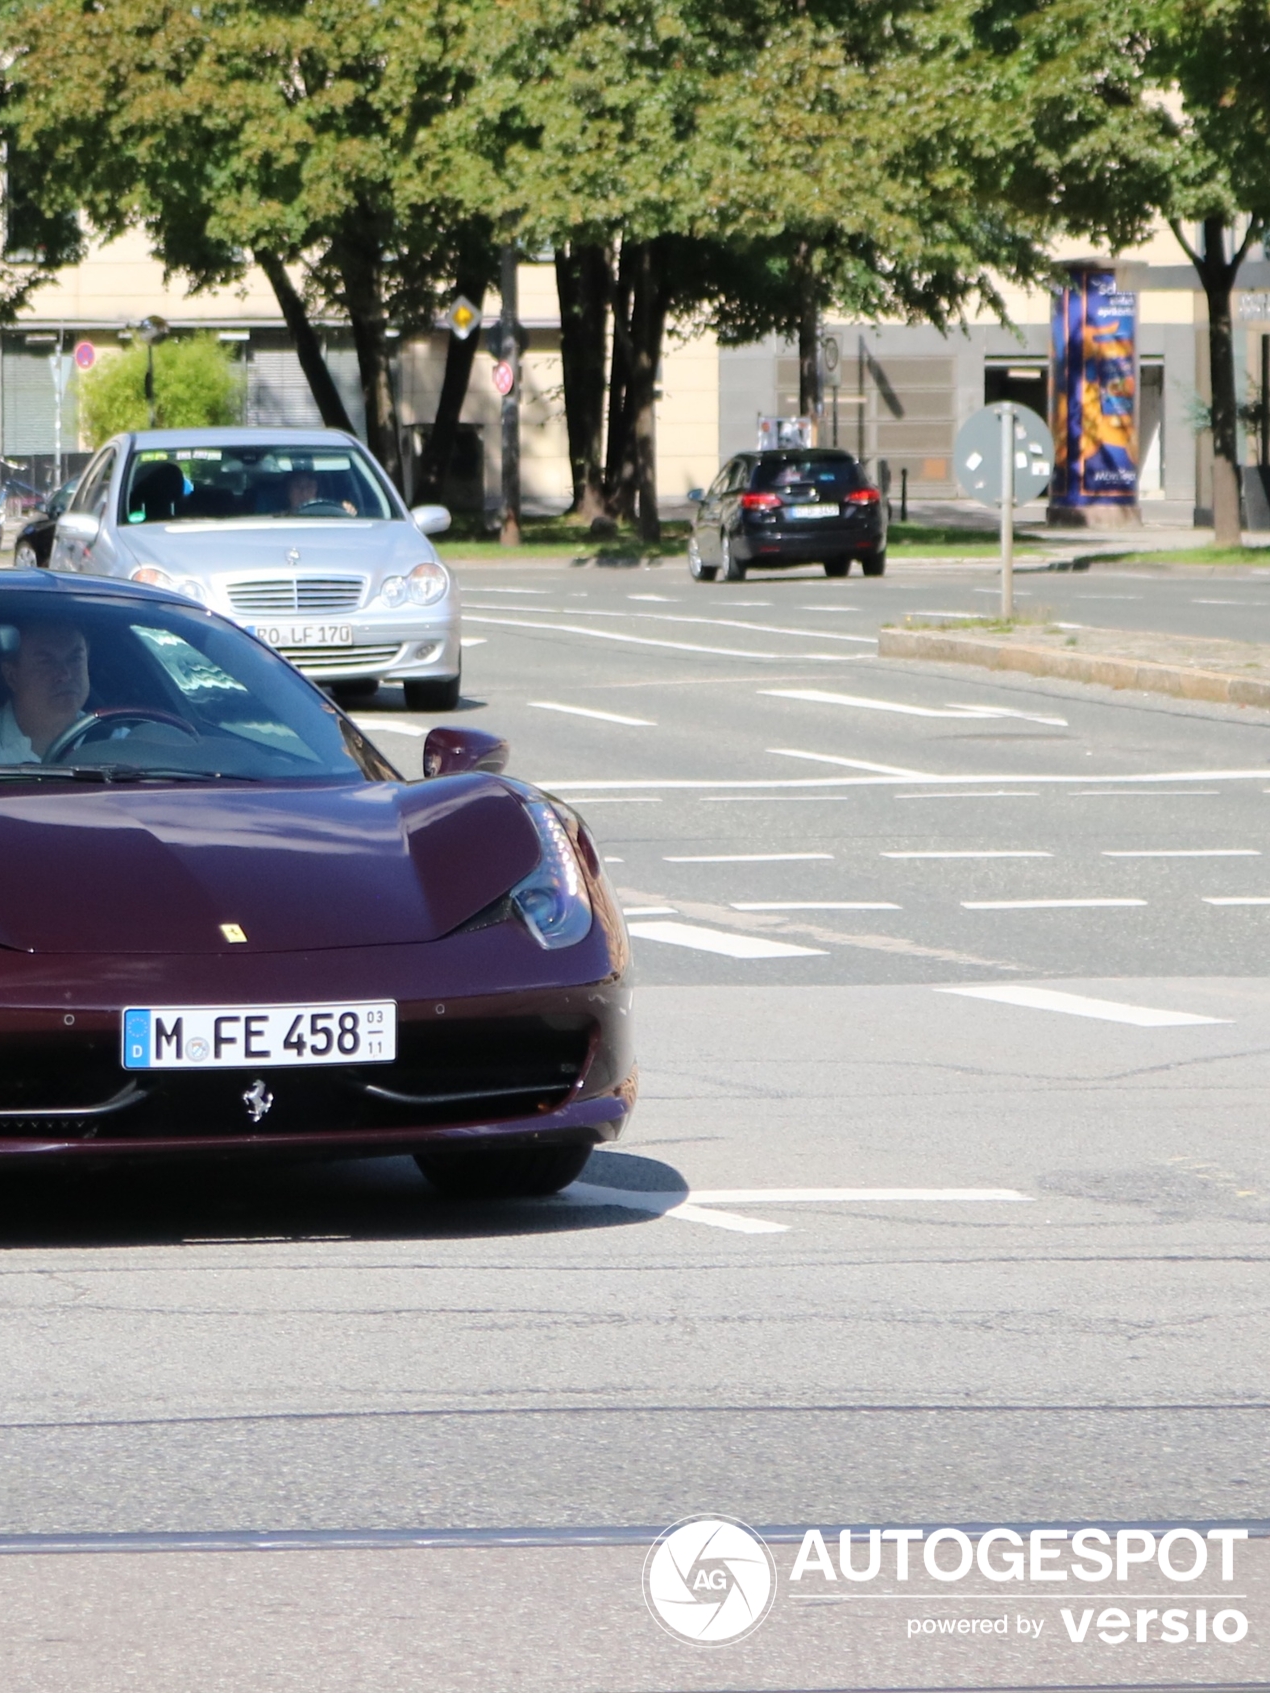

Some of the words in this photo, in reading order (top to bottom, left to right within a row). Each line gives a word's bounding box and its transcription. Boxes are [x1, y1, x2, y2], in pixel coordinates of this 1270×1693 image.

[291, 627, 314, 644] LF
[318, 625, 350, 643] 170
[367, 1010, 384, 1023] 03
[155, 1016, 184, 1060] M
[214, 1014, 271, 1059] FE
[283, 1011, 361, 1058] 458
[132, 1044, 143, 1058] D
[367, 1041, 383, 1054] 11
